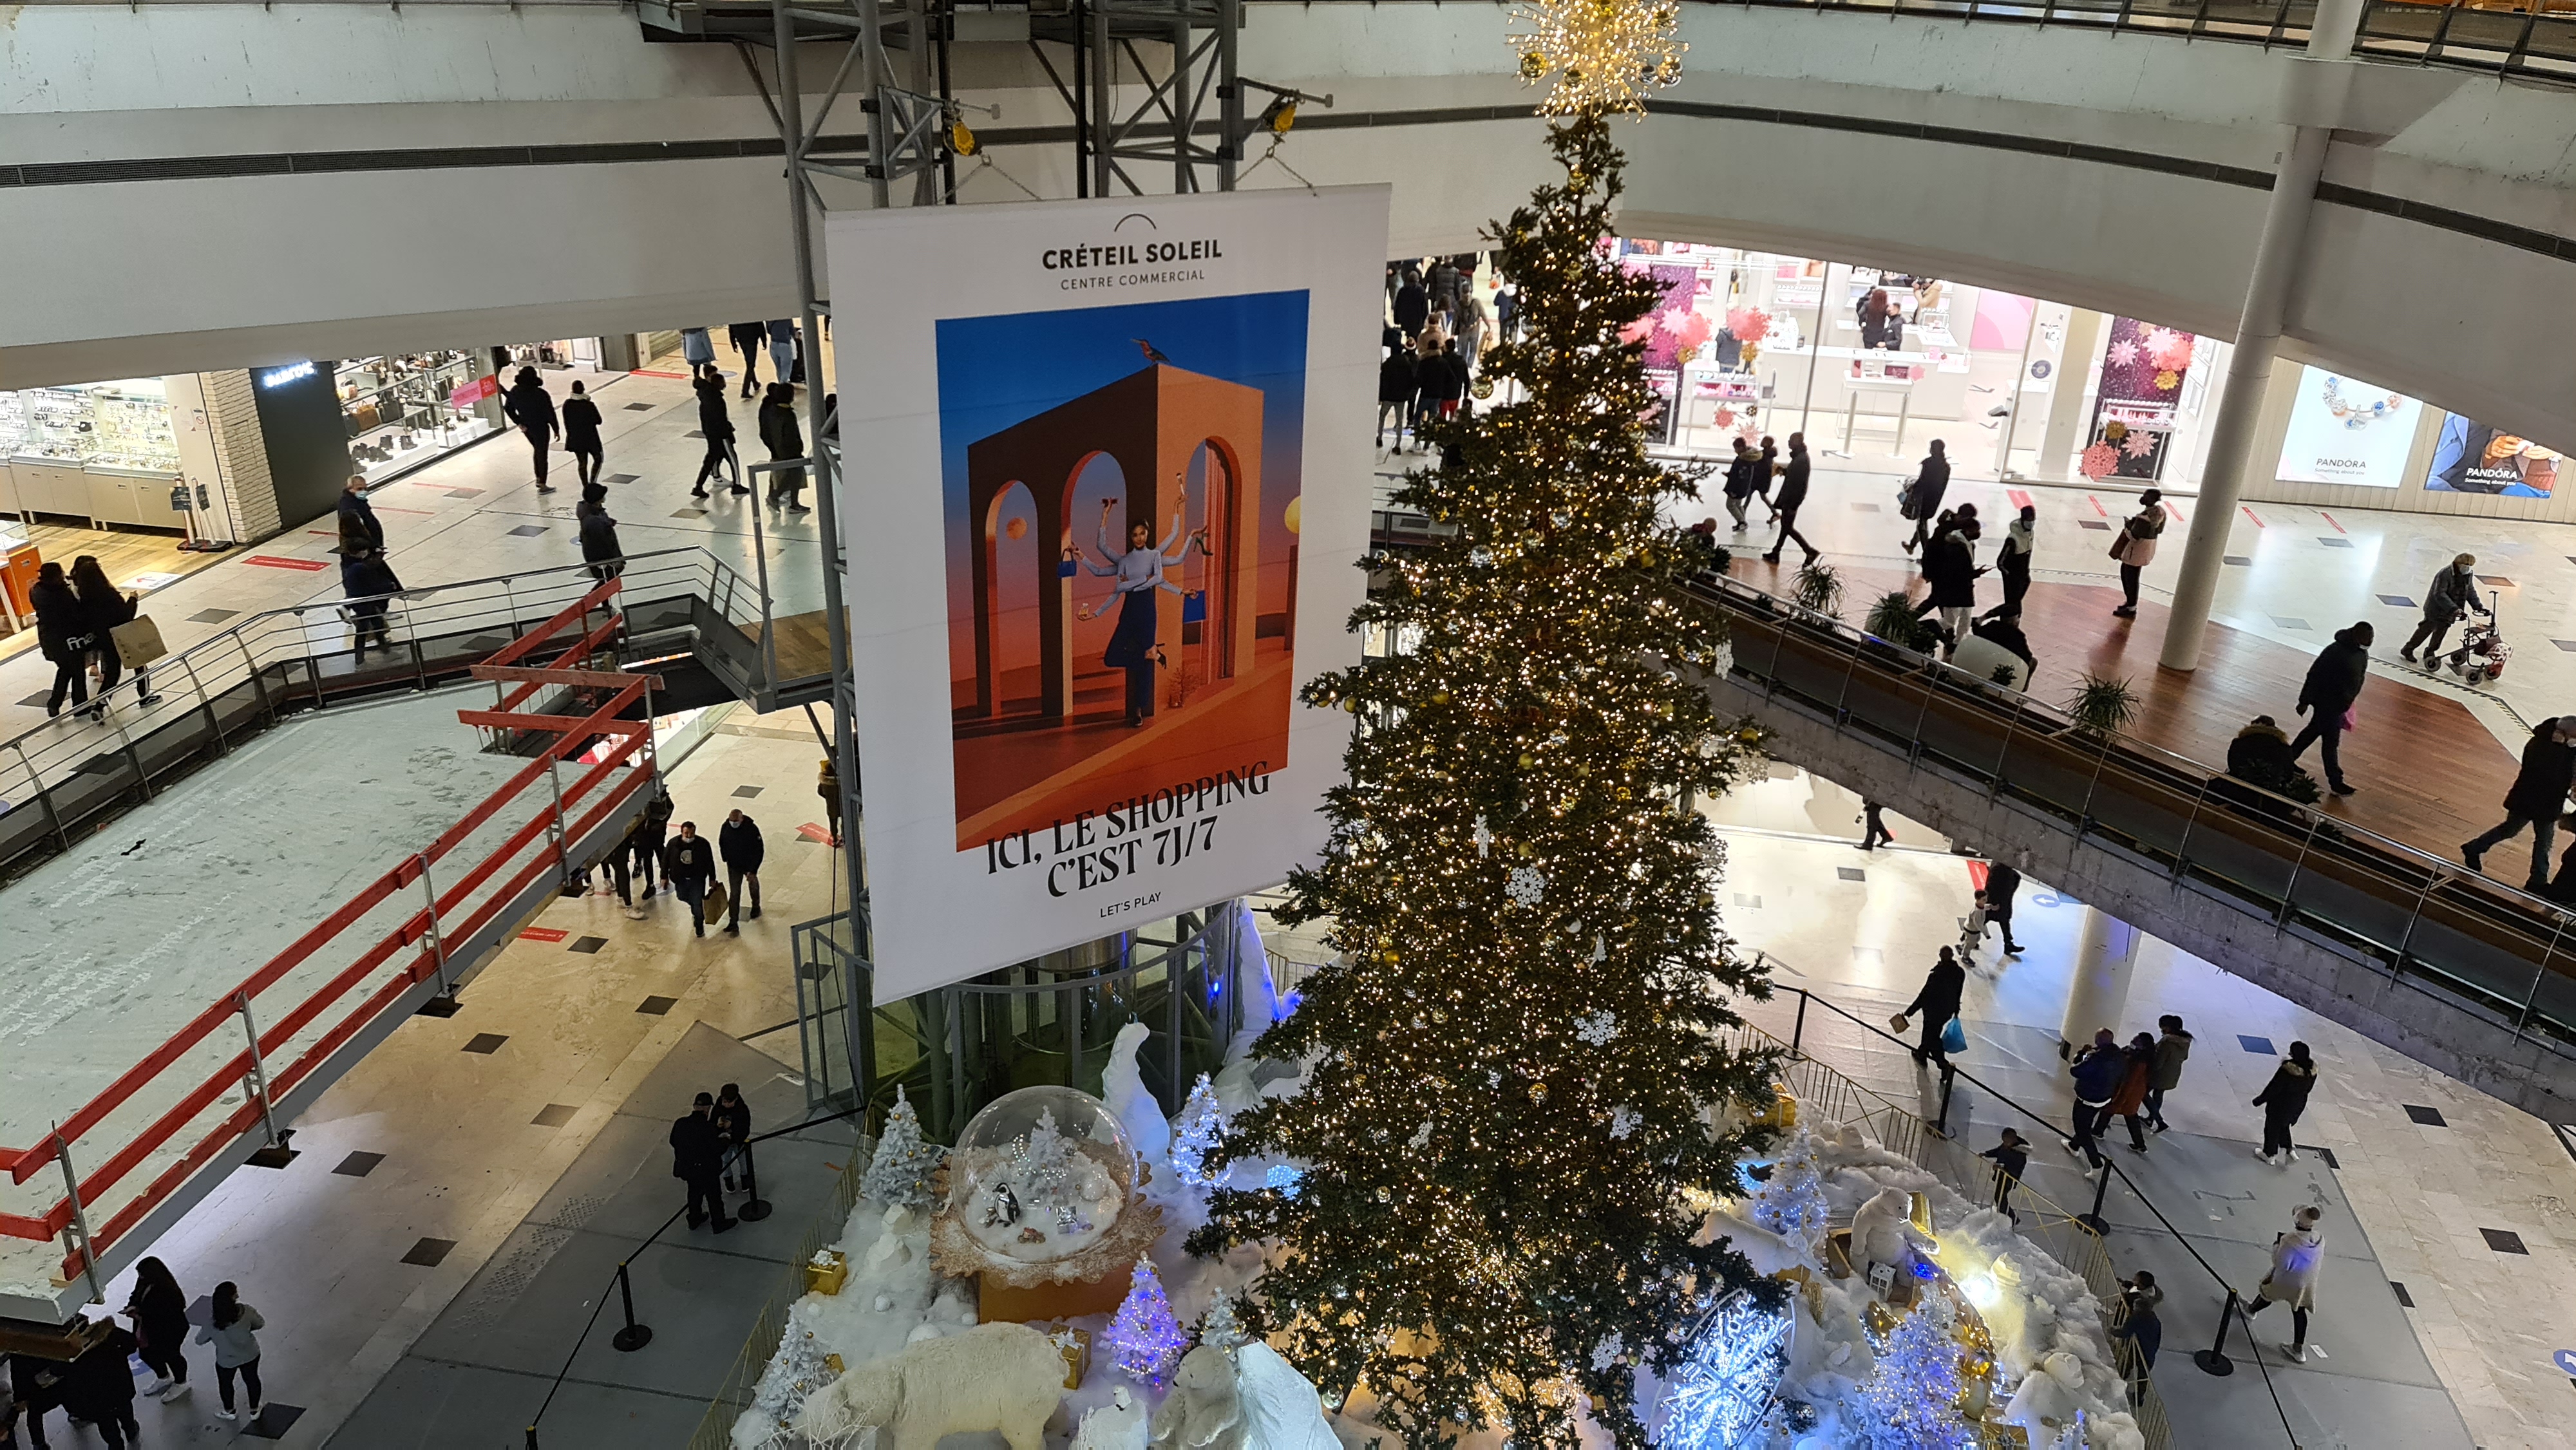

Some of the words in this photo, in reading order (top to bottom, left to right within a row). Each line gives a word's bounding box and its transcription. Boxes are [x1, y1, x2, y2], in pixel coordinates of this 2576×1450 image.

[1042, 243, 1139, 269] CRÉTEIL
[1146, 239, 1222, 263] SOLEIL
[1061, 276, 1113, 290] CENTRE
[1119, 269, 1205, 286] COMMERCIAL
[2316, 458, 2366, 468] PANDORA
[2466, 467, 2518, 479] PANDORA
[66, 632, 96, 651] fna
[987, 828, 1042, 874] ICI,
[1052, 809, 1096, 855] LE
[1105, 760, 1270, 839] SHOPPING
[1047, 838, 1142, 898] C'EST
[1153, 814, 1218, 867] 7J/7
[1099, 901, 1131, 918] LET'S
[1133, 891, 1162, 909] PLAY
